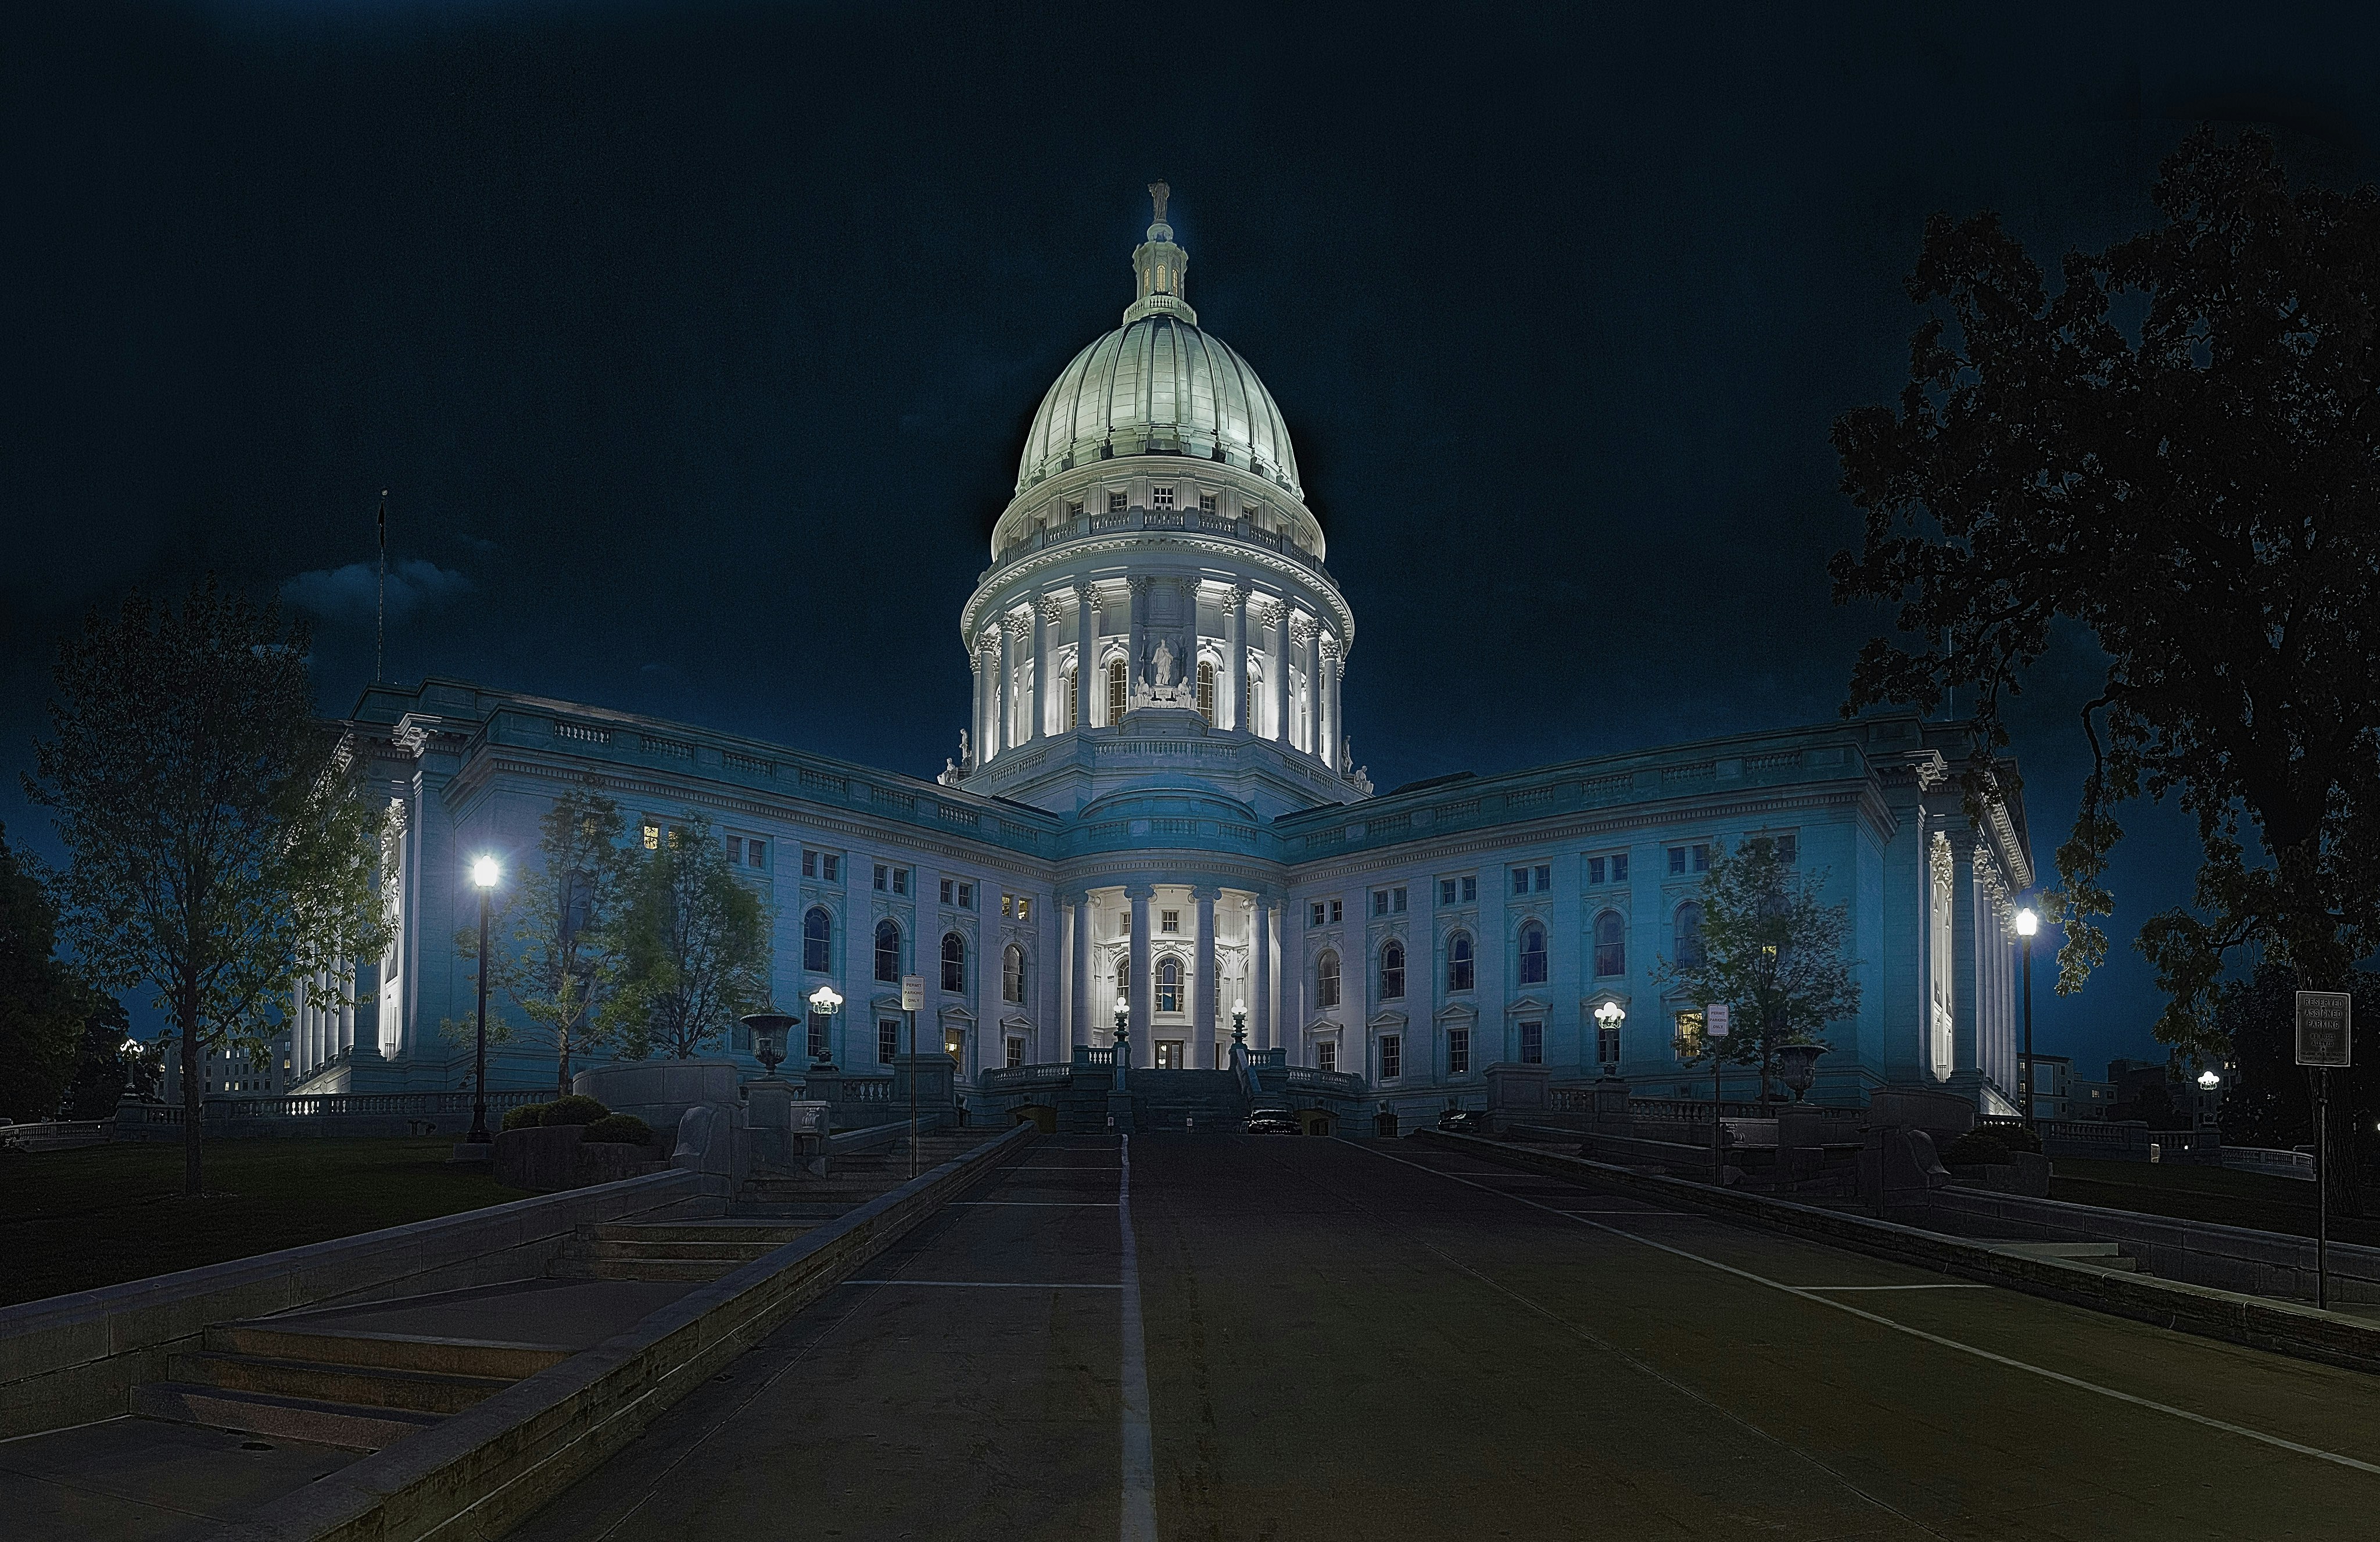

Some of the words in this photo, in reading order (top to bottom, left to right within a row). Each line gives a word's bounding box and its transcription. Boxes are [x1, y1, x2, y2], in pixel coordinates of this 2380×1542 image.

[2304, 999, 2343, 1007] RESERVED
[2305, 1010, 2341, 1018] ASSIGNED
[2307, 1020, 2339, 1029] PARKING
